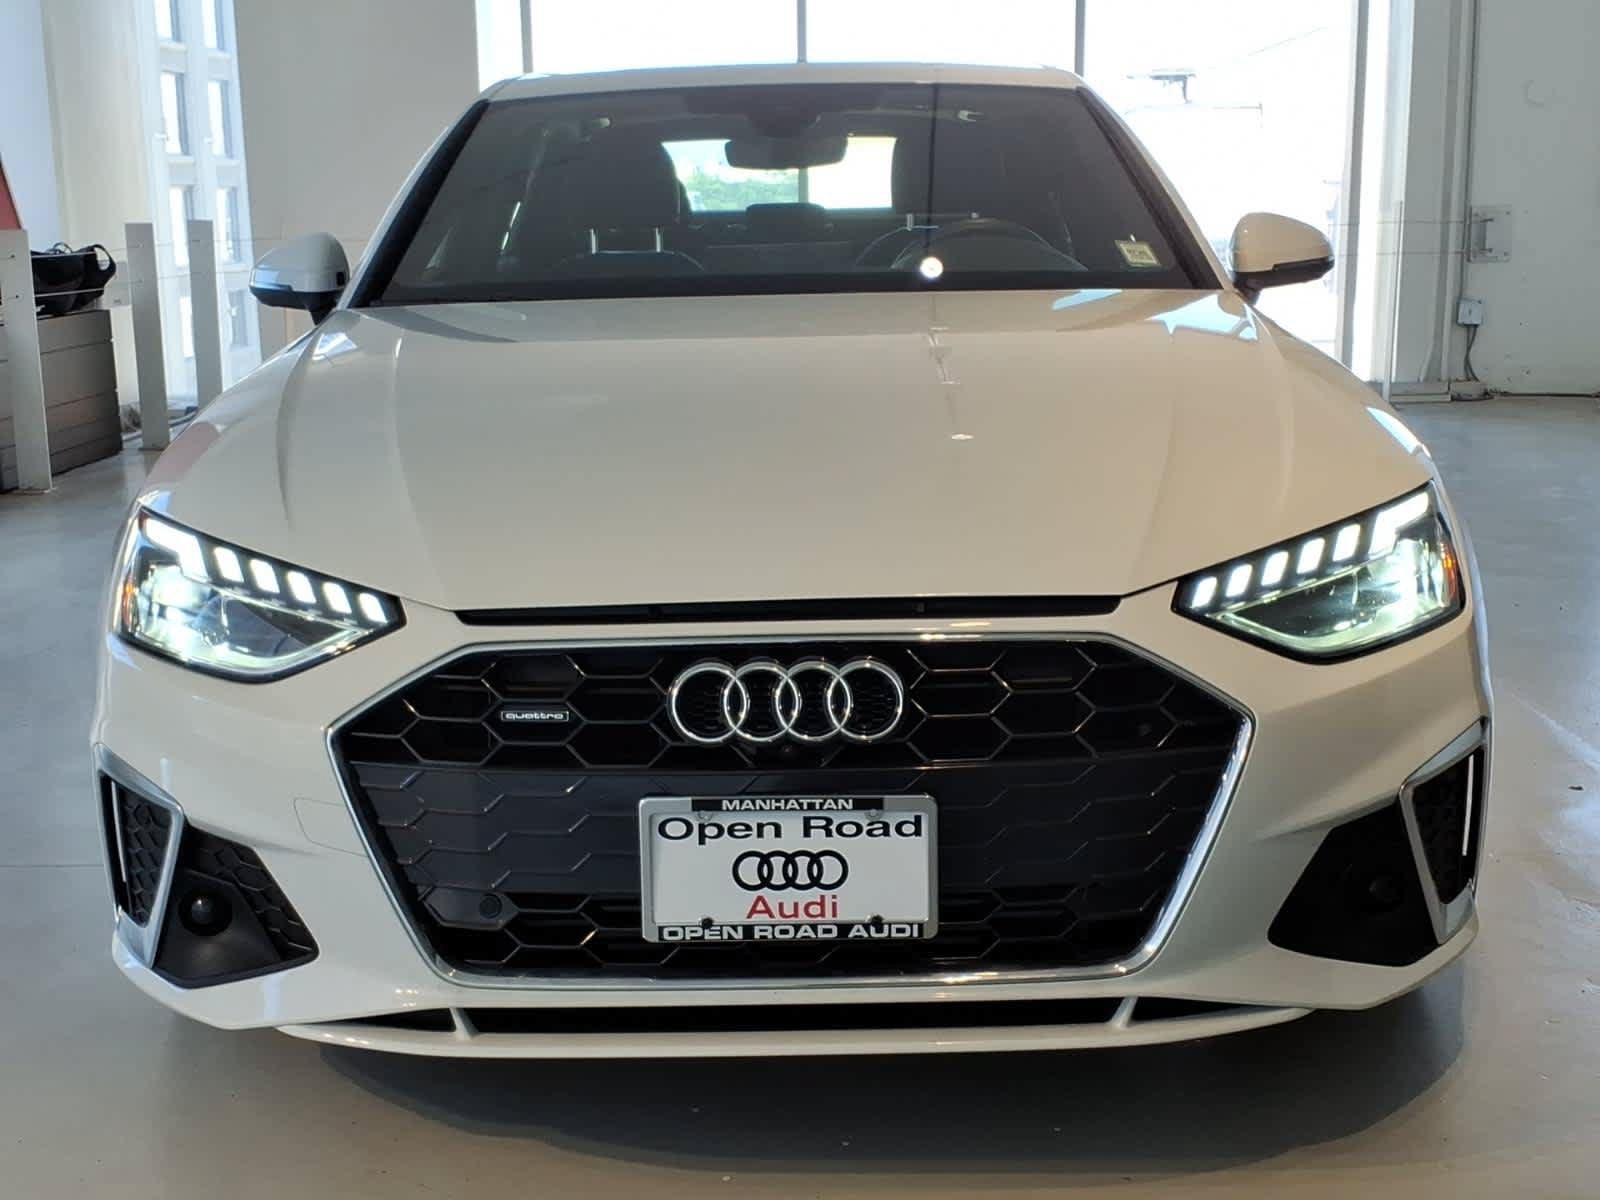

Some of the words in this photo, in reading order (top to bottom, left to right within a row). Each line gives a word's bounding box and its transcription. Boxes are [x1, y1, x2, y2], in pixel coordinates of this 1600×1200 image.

[505, 712, 564, 721] quattro
[722, 799, 853, 811] MANHATTAN
[657, 816, 782, 846] Open
[802, 814, 923, 838] Road
[746, 894, 839, 919] Audi
[662, 925, 744, 941] OPEN
[753, 924, 839, 939] ROAD
[848, 923, 919, 939] AUDI
